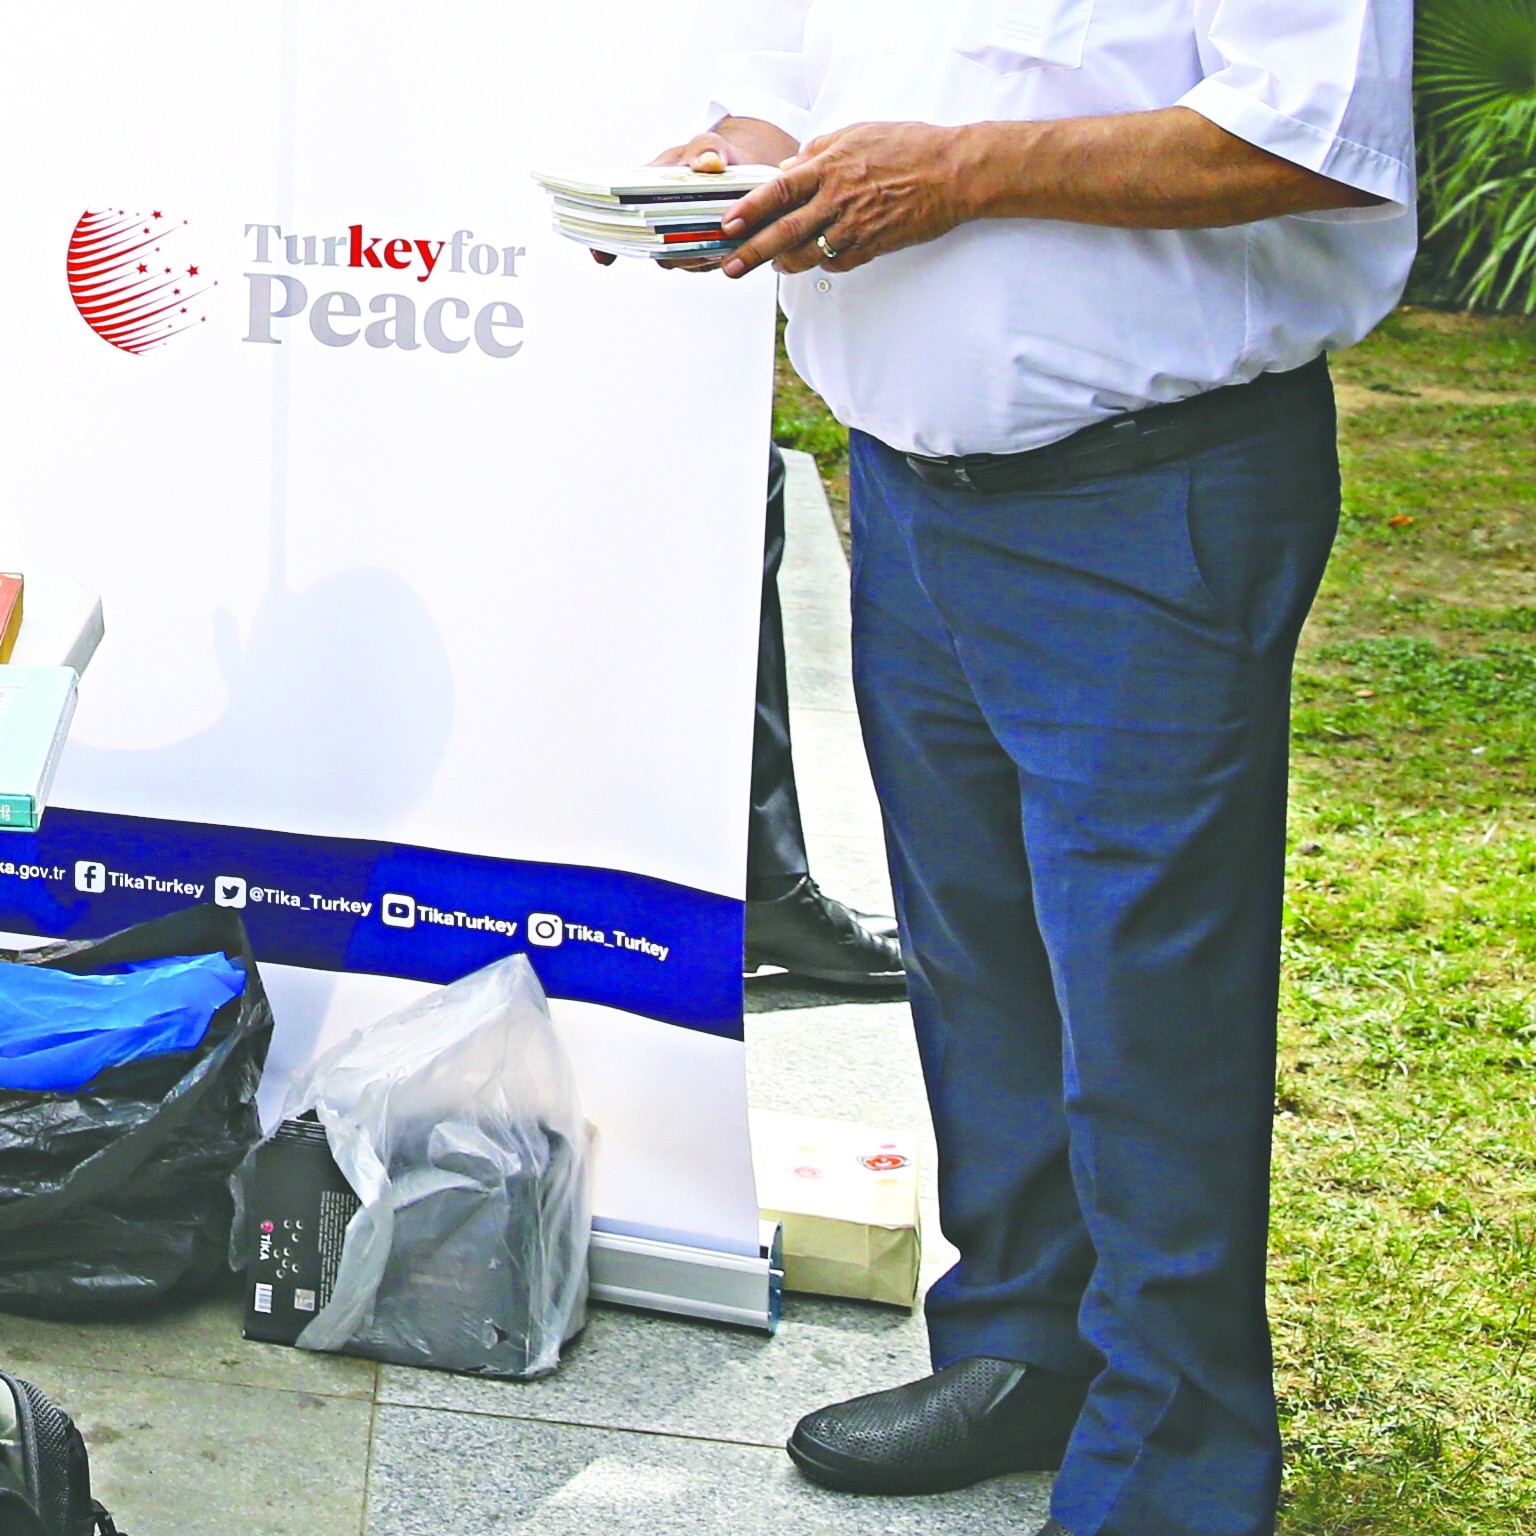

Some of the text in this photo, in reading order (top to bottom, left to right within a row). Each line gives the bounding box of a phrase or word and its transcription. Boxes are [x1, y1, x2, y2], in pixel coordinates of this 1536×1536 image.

[242, 272, 524, 359] Peace
[108, 871, 205, 899] TikaTurkey
[249, 886, 372, 916] @Tika_Turkey
[417, 905, 518, 936] TikaTurkey
[565, 923, 669, 960] Tika_Turkey
